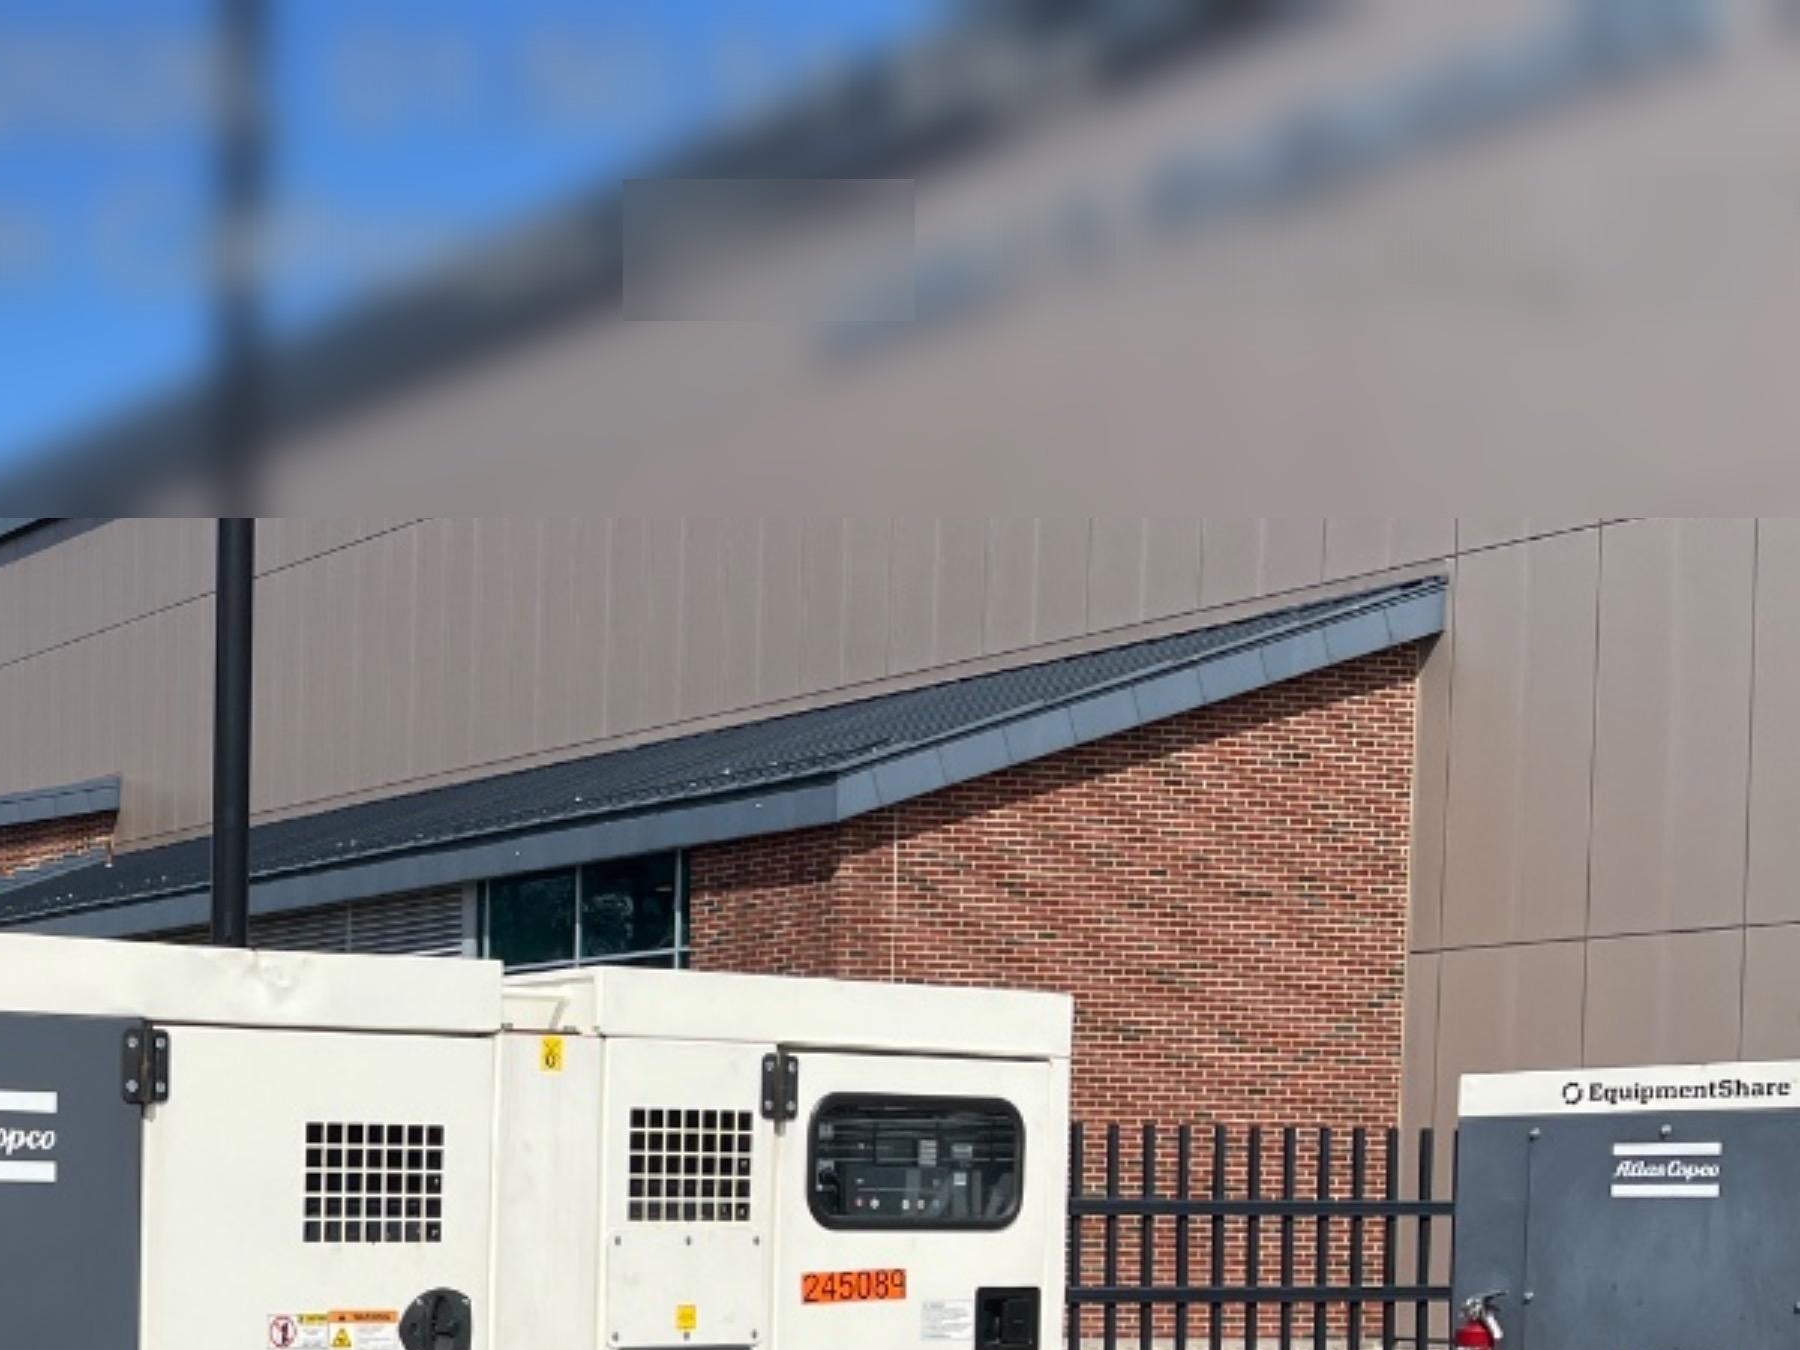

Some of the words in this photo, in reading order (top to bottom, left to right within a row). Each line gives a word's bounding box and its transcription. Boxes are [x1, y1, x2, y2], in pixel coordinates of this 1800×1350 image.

[1589, 1078, 1792, 1105] EquipmentShare
[1613, 1160, 1665, 1179] Atlas
[1666, 1159, 1720, 1181] Copco
[802, 1268, 906, 1304] 245089
